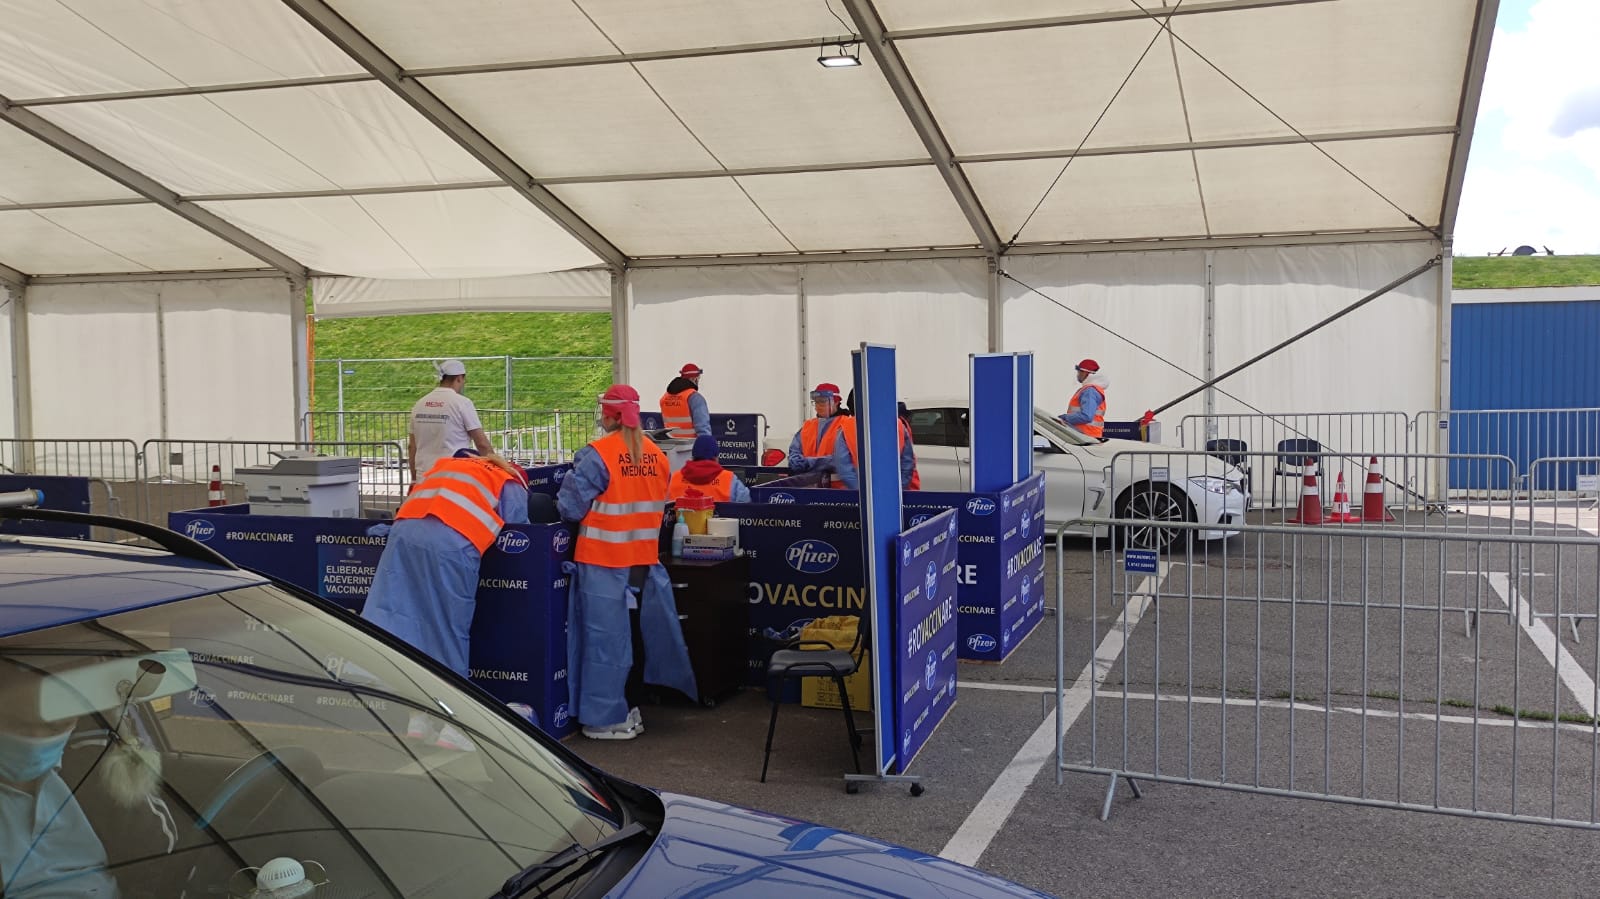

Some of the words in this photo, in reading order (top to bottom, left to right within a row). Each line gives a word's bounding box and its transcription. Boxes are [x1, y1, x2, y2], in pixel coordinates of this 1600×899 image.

[618, 453, 658, 465] ASENT
[621, 464, 657, 477] MEDICAL
[967, 499, 995, 515] Pfizer
[739, 518, 802, 529] ROVACCINARE
[187, 521, 214, 539] Pfizer
[225, 531, 294, 543] #ROVACCINARE
[315, 534, 387, 546] #ROVACCINARE
[497, 532, 529, 552] Pfizer
[957, 535, 996, 544] CCINARE
[787, 542, 838, 571] Pfizer
[325, 565, 376, 576] ELIBERARE
[323, 575, 374, 585] ADEVERINT
[479, 579, 528, 589] ACCINARE
[325, 584, 370, 595] VACCINAR
[748, 581, 866, 610] OVACCIN
[957, 605, 996, 615] CCINARE
[908, 595, 952, 659] #ROVACCINARE
[968, 635, 996, 651] Pfizer
[467, 668, 528, 682] OVACCINARE
